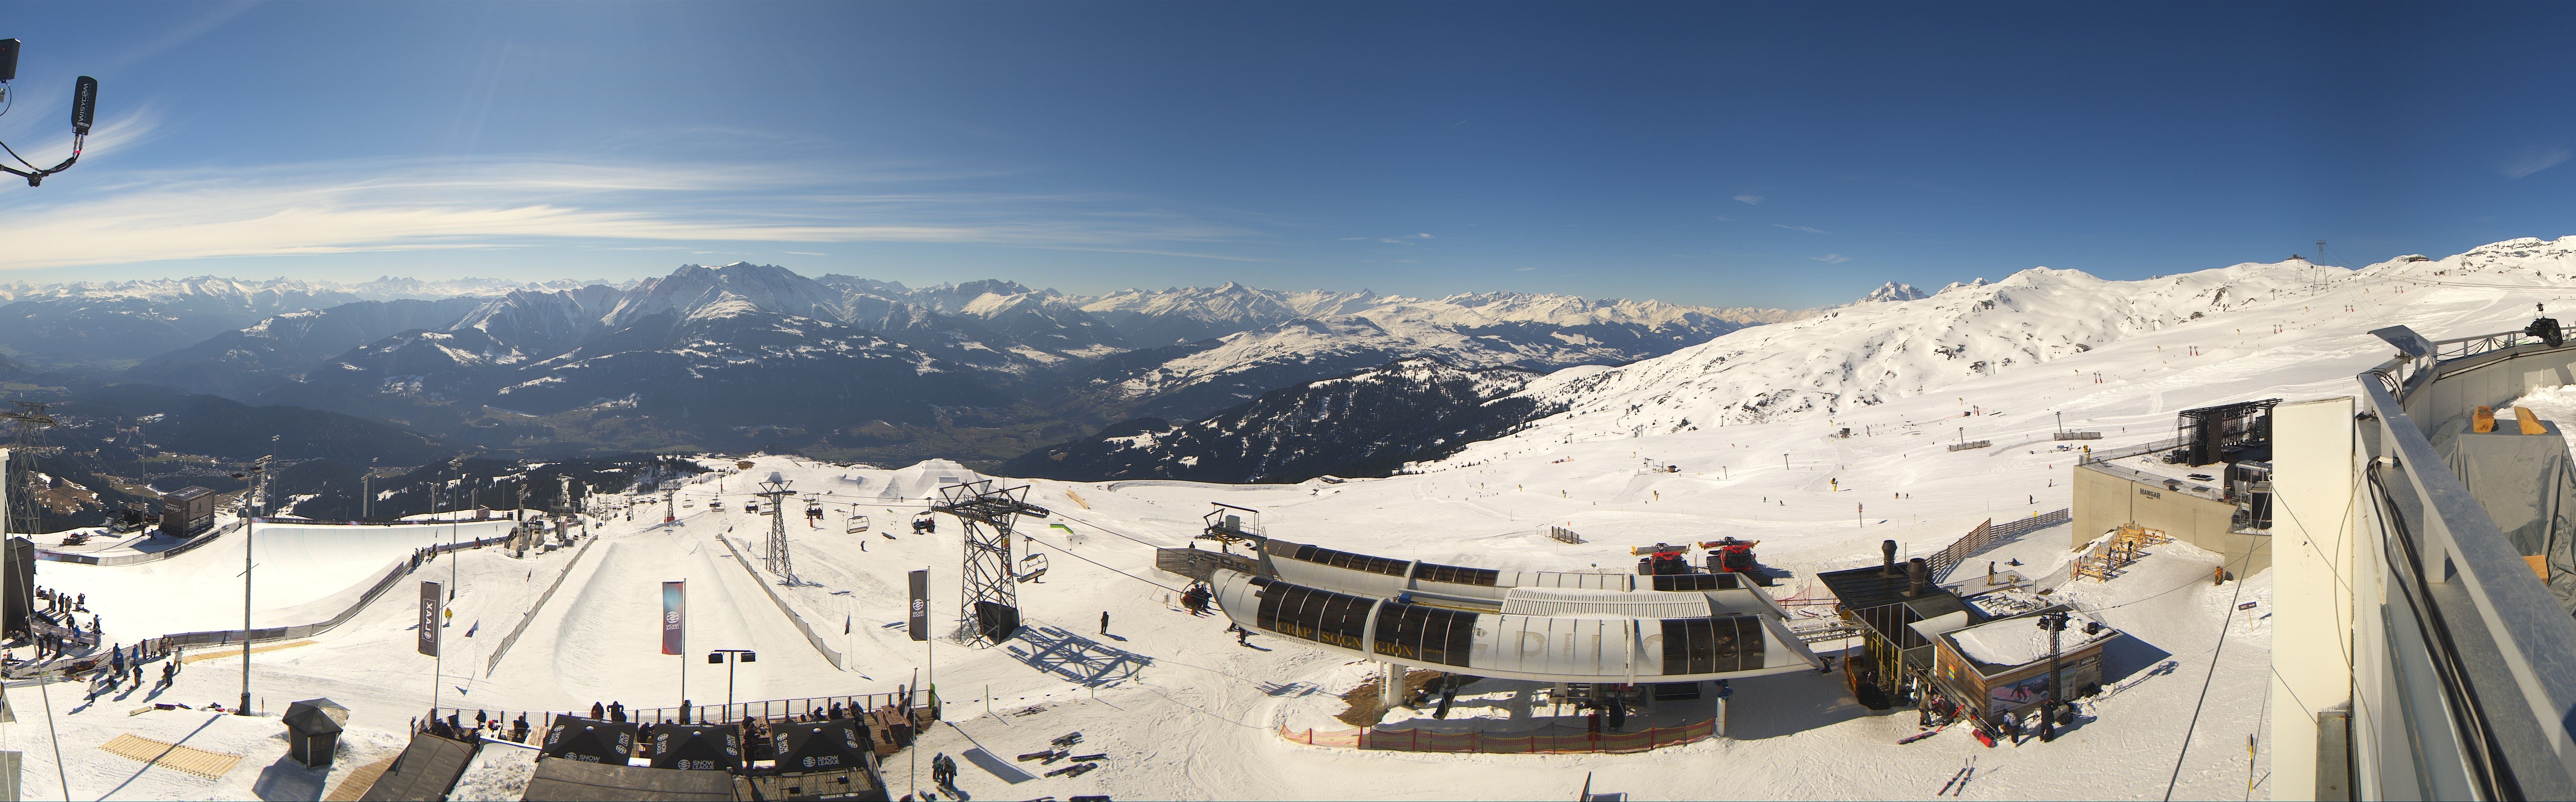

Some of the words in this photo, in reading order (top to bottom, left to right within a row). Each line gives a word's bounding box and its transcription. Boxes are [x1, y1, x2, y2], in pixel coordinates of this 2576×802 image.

[78, 83, 88, 121] WISYCOM
[2140, 488, 2160, 500] HANGAR
[1260, 630, 1286, 638] CRUISING
[1289, 637, 1317, 646] ALTITUDE
[1278, 621, 1311, 638] CRAP
[1322, 632, 1363, 649] SOGN
[1375, 641, 1413, 657] GION
[553, 732, 561, 744] SNOW
[843, 728, 852, 740] SNOW
[848, 729, 856, 741] LEAGUE
